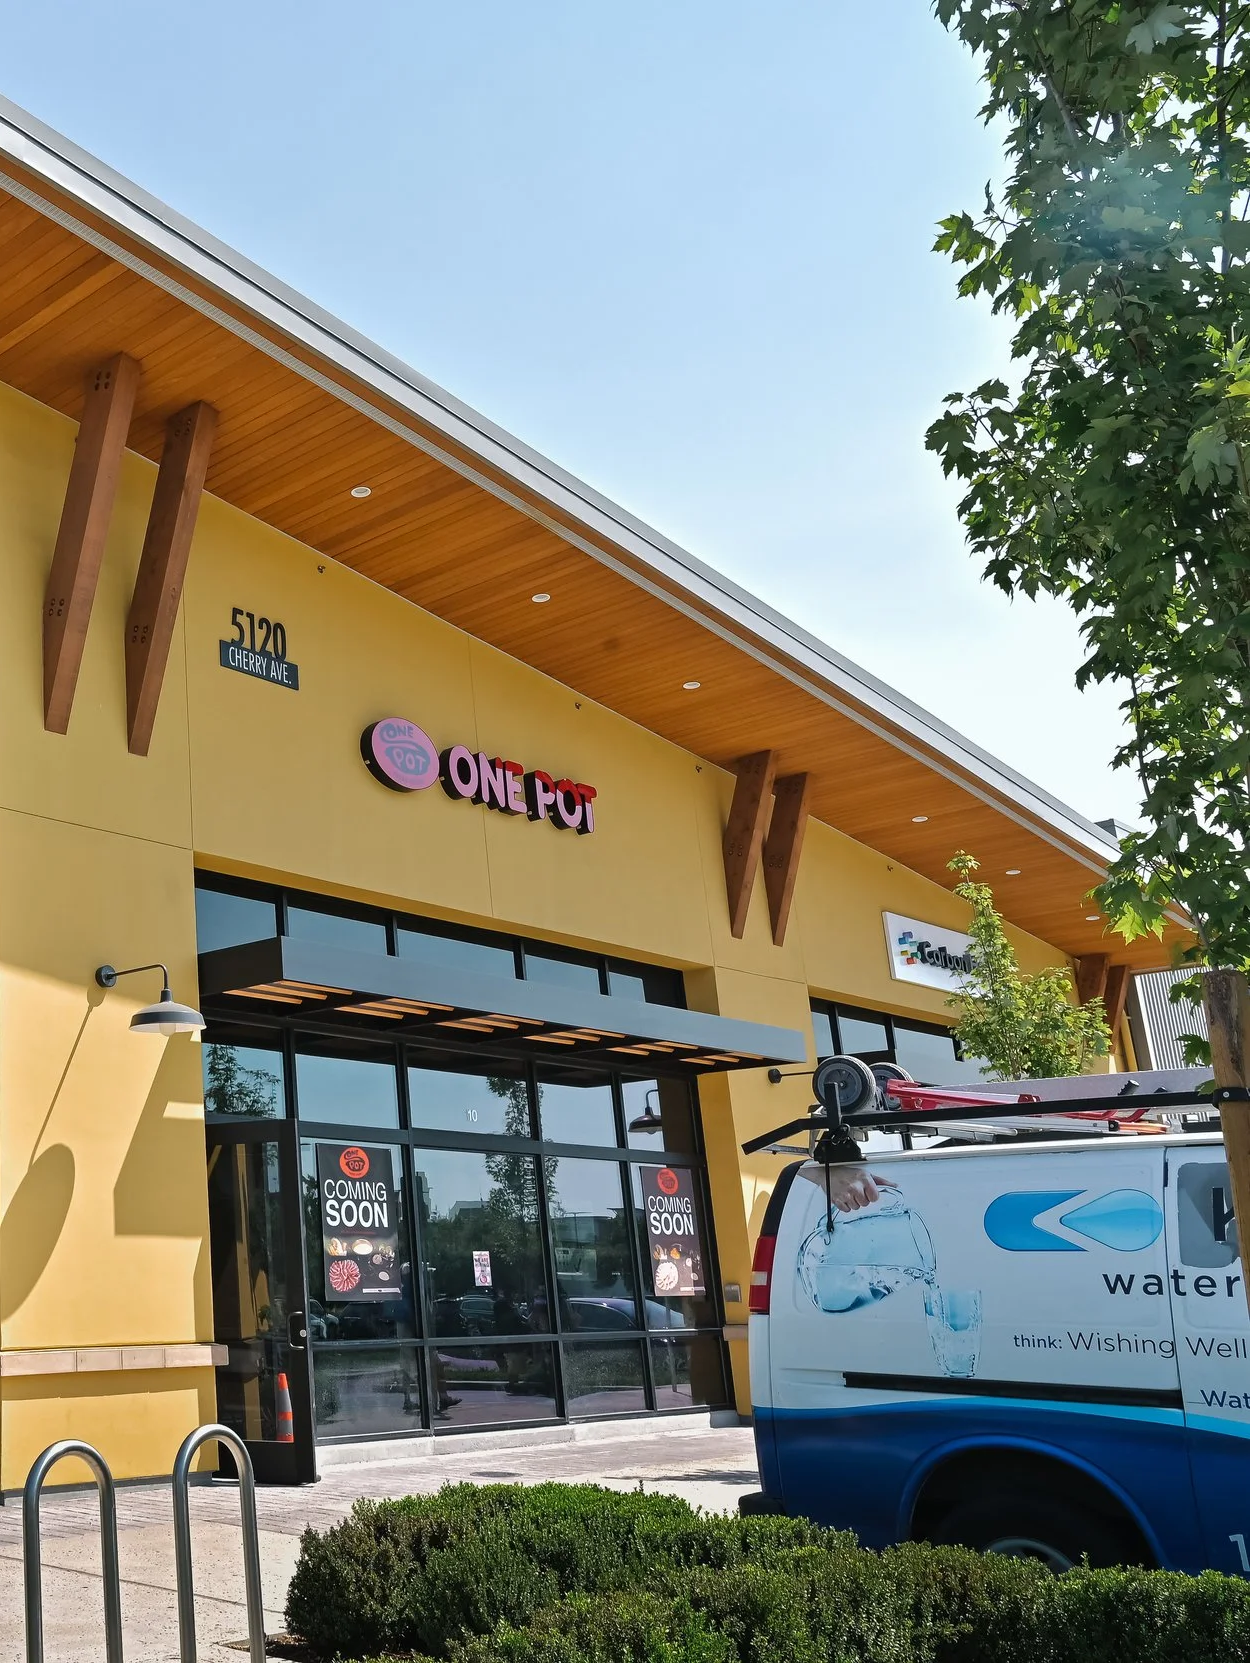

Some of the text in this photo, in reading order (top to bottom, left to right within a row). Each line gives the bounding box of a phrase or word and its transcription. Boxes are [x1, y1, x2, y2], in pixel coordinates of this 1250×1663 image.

[231, 607, 286, 661] 5120
[229, 646, 292, 684] CHERRY AVE.
[379, 723, 414, 740] ONE
[393, 748, 426, 773] POT
[441, 744, 598, 835] ONE POT
[917, 941, 970, 974] Carbon
[324, 1179, 387, 1201] COMING
[648, 1195, 692, 1213] COMING
[325, 1199, 389, 1228] SOON
[650, 1212, 695, 1236] SOON
[1102, 1269, 1241, 1298] water
[1013, 1331, 1247, 1359] think: Wishing Well
